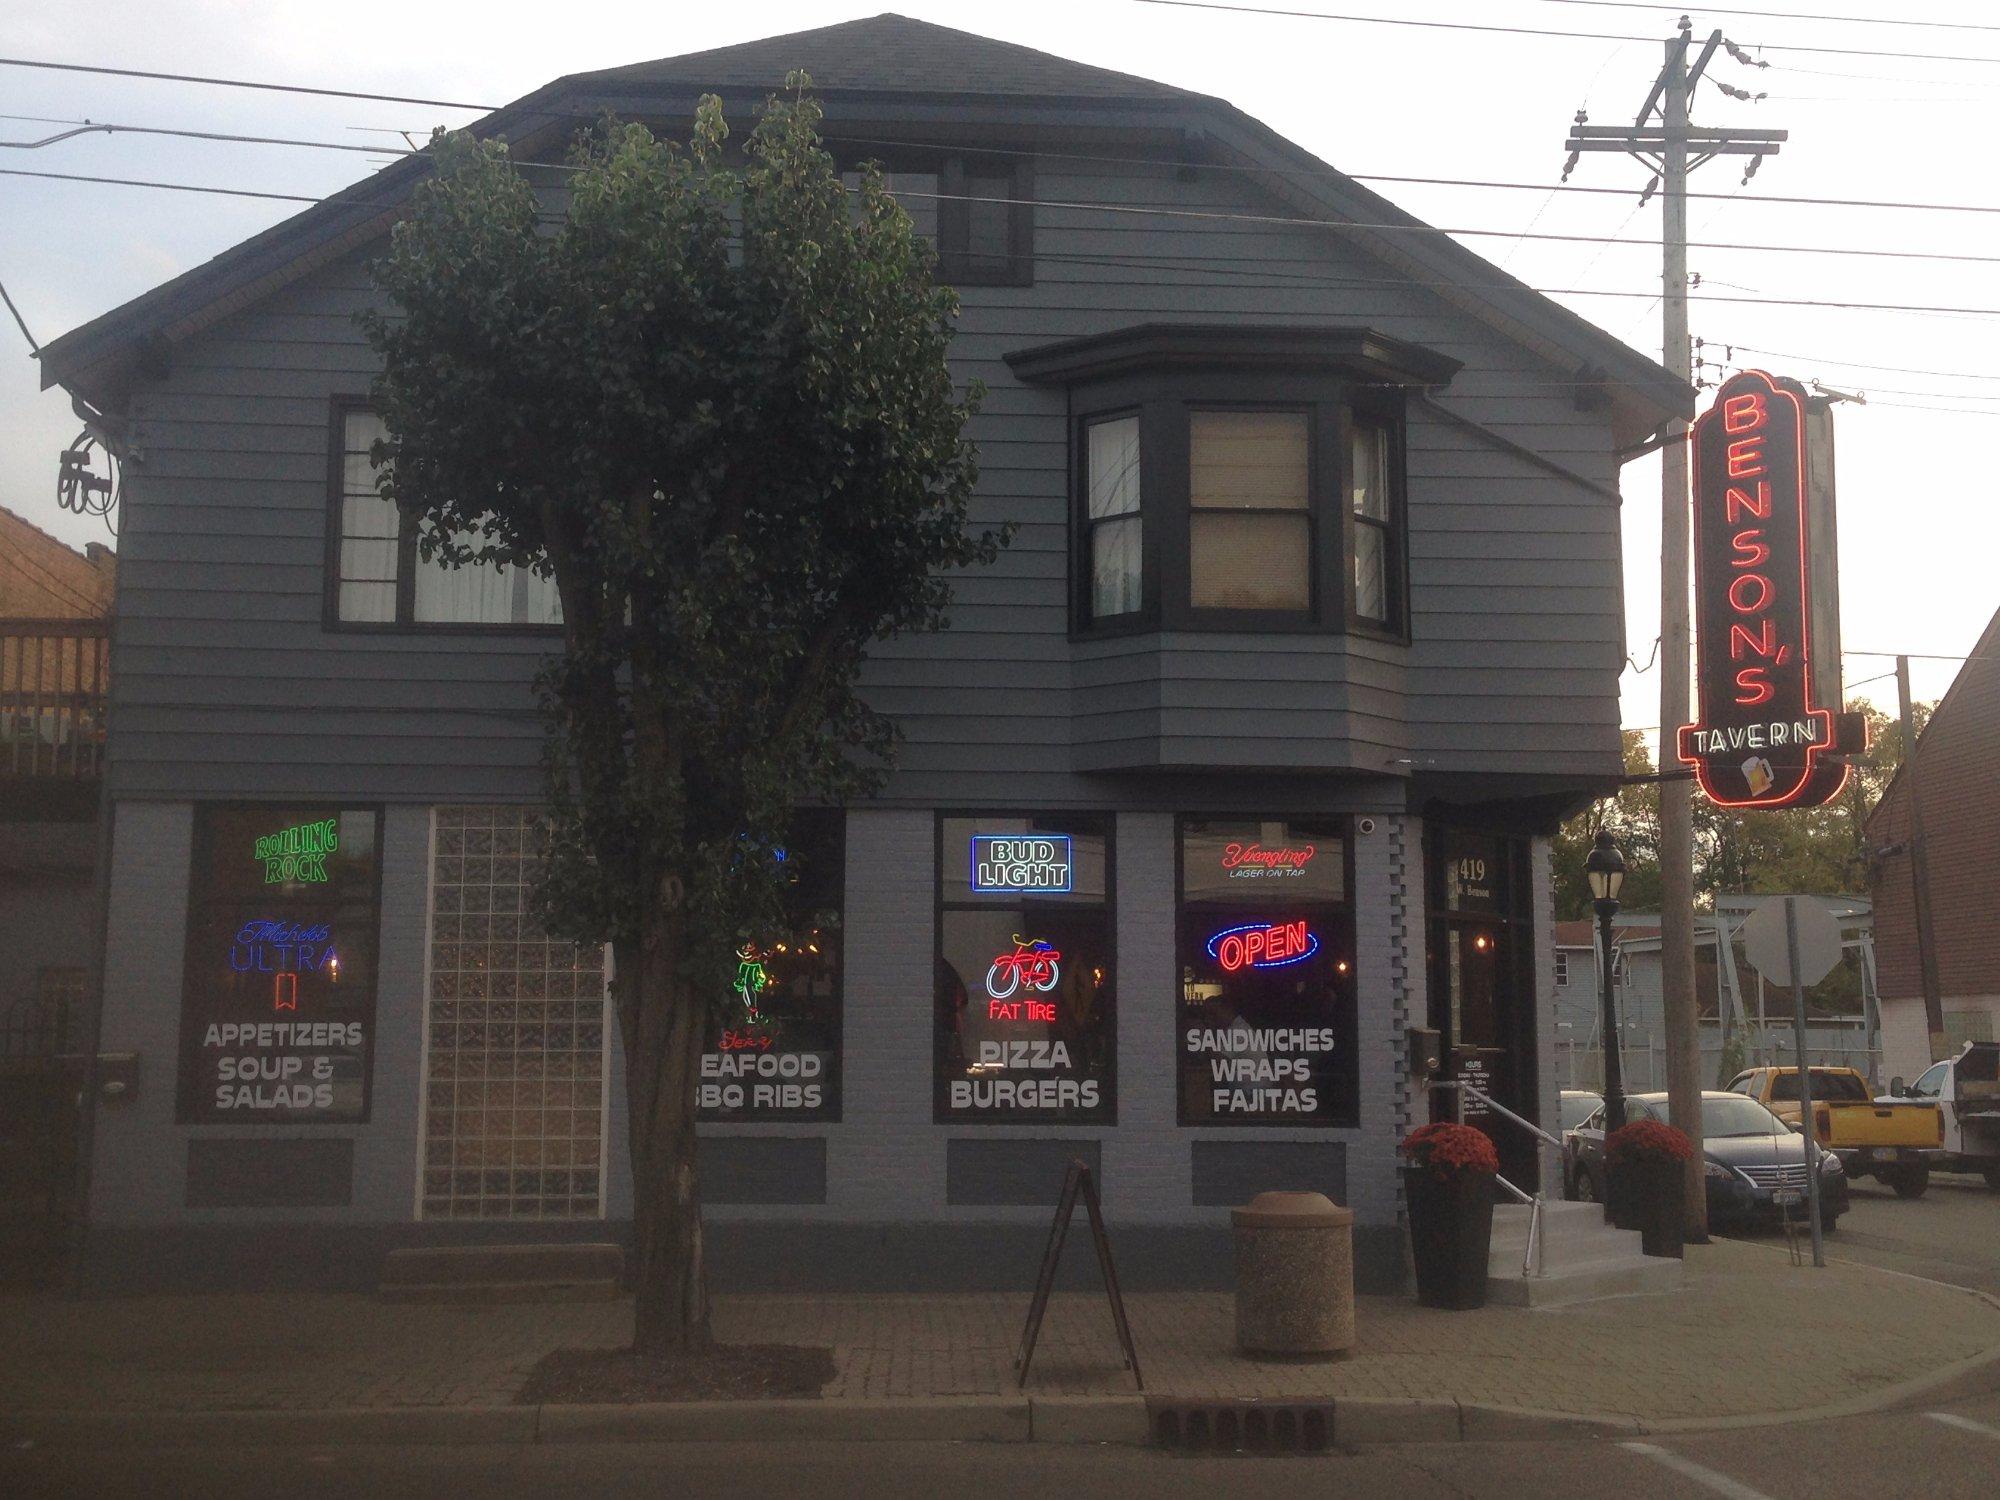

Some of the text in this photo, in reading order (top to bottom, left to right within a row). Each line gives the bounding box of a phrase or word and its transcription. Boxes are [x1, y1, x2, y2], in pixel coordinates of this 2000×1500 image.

[1724, 393, 1793, 705] BENSON'S
[1693, 718, 1817, 753] TAVERN
[254, 819, 338, 859] ROLLING
[990, 840, 1055, 863] BUD
[1222, 842, 1315, 868] Yuengling
[264, 853, 327, 883] ROCK
[978, 863, 1067, 886] LIGHT
[1229, 869, 1305, 878] LAGER ON TAP
[1460, 858, 1485, 881] 419
[231, 944, 342, 971] ULTRA
[1220, 920, 1307, 971] OPEN
[989, 1000, 1056, 1021] FAT TIRE
[203, 1022, 362, 1047] APPETIZERS
[1187, 1028, 1335, 1051] SANDWICHES
[700, 1054, 821, 1077] EAFOOD
[980, 1041, 1071, 1068] PIZZA
[217, 1056, 334, 1080] SOUP &
[1211, 1058, 1310, 1081] WRAPS
[215, 1084, 334, 1109] SALADS
[696, 1084, 822, 1107] BQ RIBS
[951, 1079, 1099, 1108] BURGERS
[1213, 1088, 1317, 1112] FAJITAS
